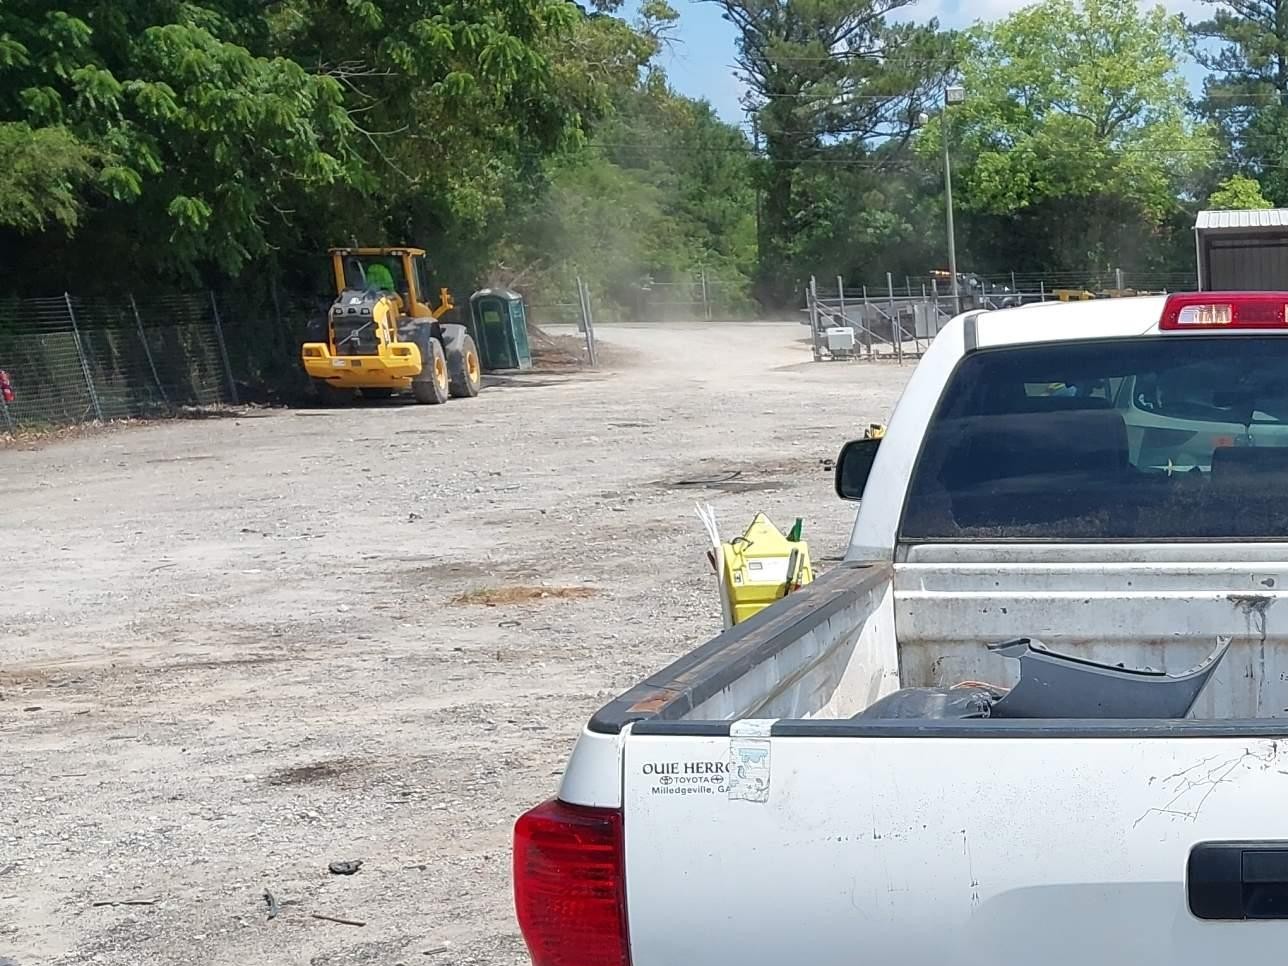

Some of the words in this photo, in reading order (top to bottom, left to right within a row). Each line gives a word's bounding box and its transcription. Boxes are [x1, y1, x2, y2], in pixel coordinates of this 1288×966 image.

[642, 762, 680, 775] OUIE
[674, 776, 710, 784] TOYOTA
[651, 786, 715, 796] Milledgeville,
[717, 785, 731, 793] GA
